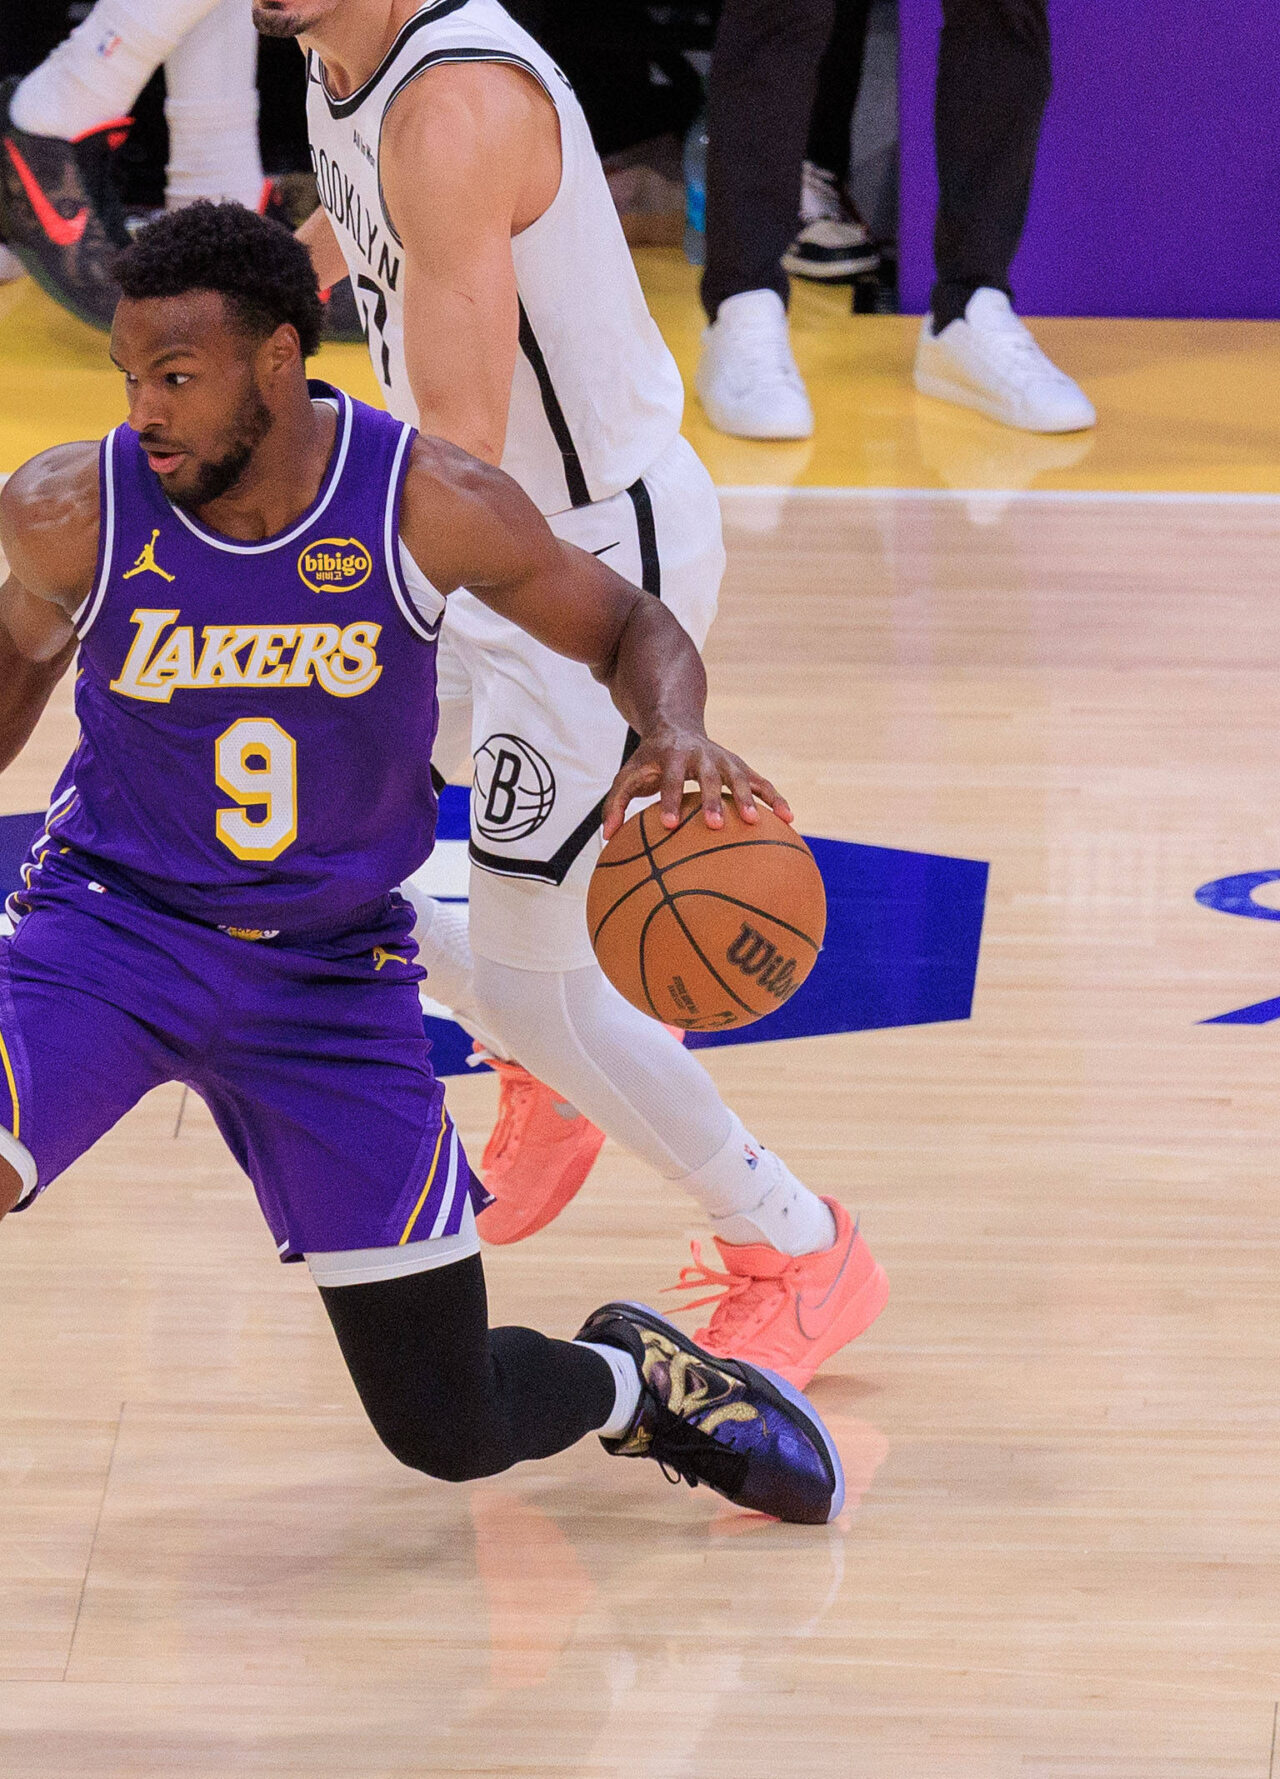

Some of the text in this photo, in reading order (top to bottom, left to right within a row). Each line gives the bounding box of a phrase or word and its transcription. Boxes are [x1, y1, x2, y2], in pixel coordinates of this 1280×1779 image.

[357, 273, 391, 388] 7
[305, 552, 367, 576] bibigo
[110, 608, 383, 703] LAKERS
[215, 717, 298, 861] 9
